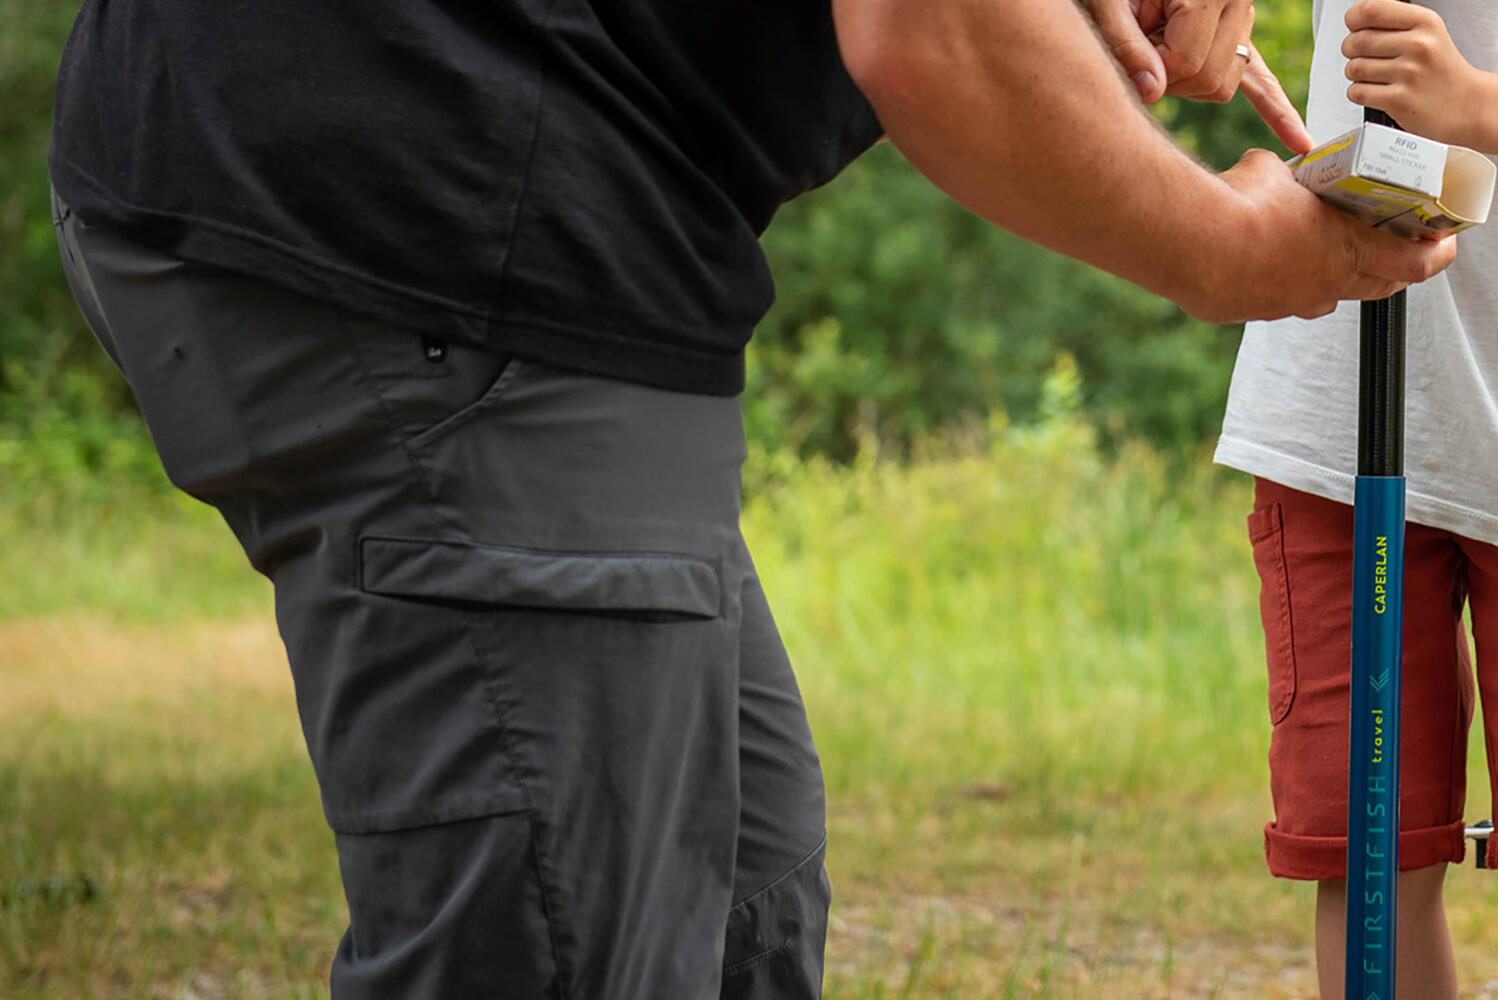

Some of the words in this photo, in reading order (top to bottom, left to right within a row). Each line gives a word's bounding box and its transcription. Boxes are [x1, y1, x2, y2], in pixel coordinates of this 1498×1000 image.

[1394, 136, 1418, 151] RFID
[1374, 536, 1388, 614] CAPERLAN
[1371, 709, 1383, 764] travel
[1363, 775, 1386, 974] FIRSTFISH
